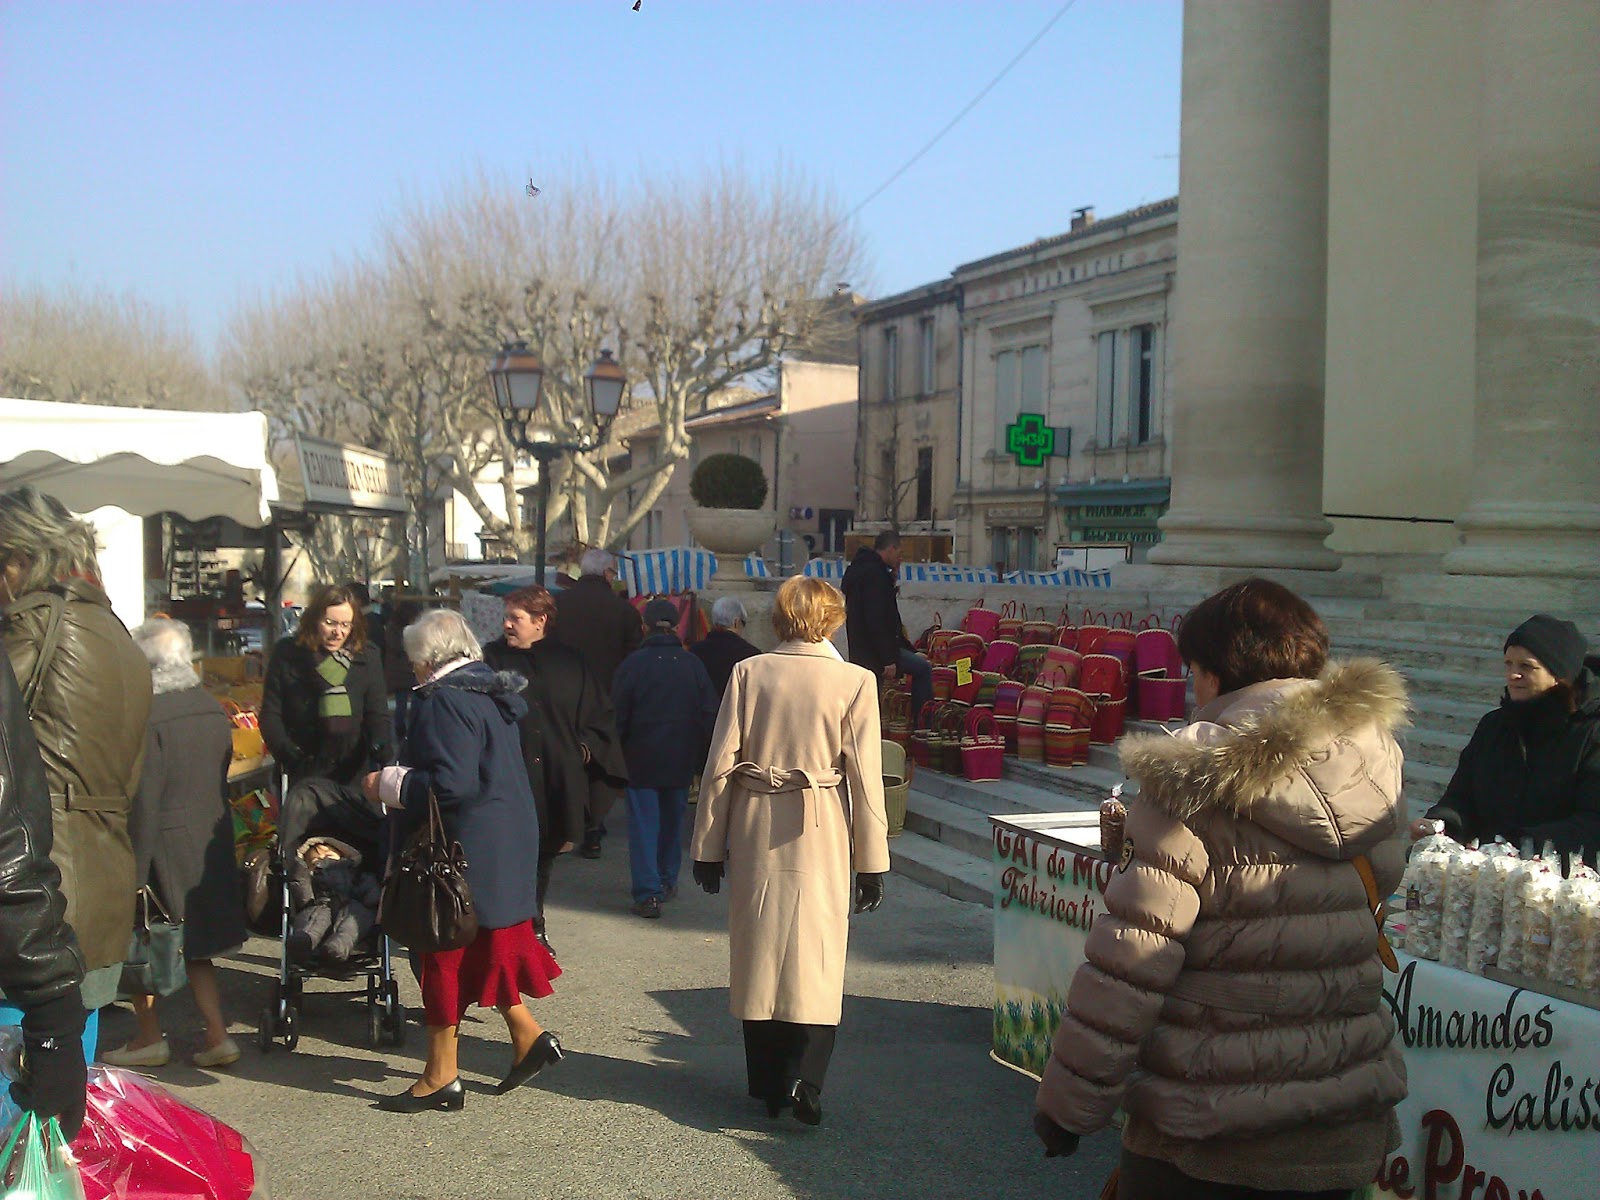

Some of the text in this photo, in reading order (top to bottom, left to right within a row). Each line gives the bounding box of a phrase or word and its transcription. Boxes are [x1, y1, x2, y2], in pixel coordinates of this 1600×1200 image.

[1086, 505, 1147, 518] PHARMACIE
[1047, 847, 1066, 880] de
[1382, 961, 1556, 1053] Amandes
